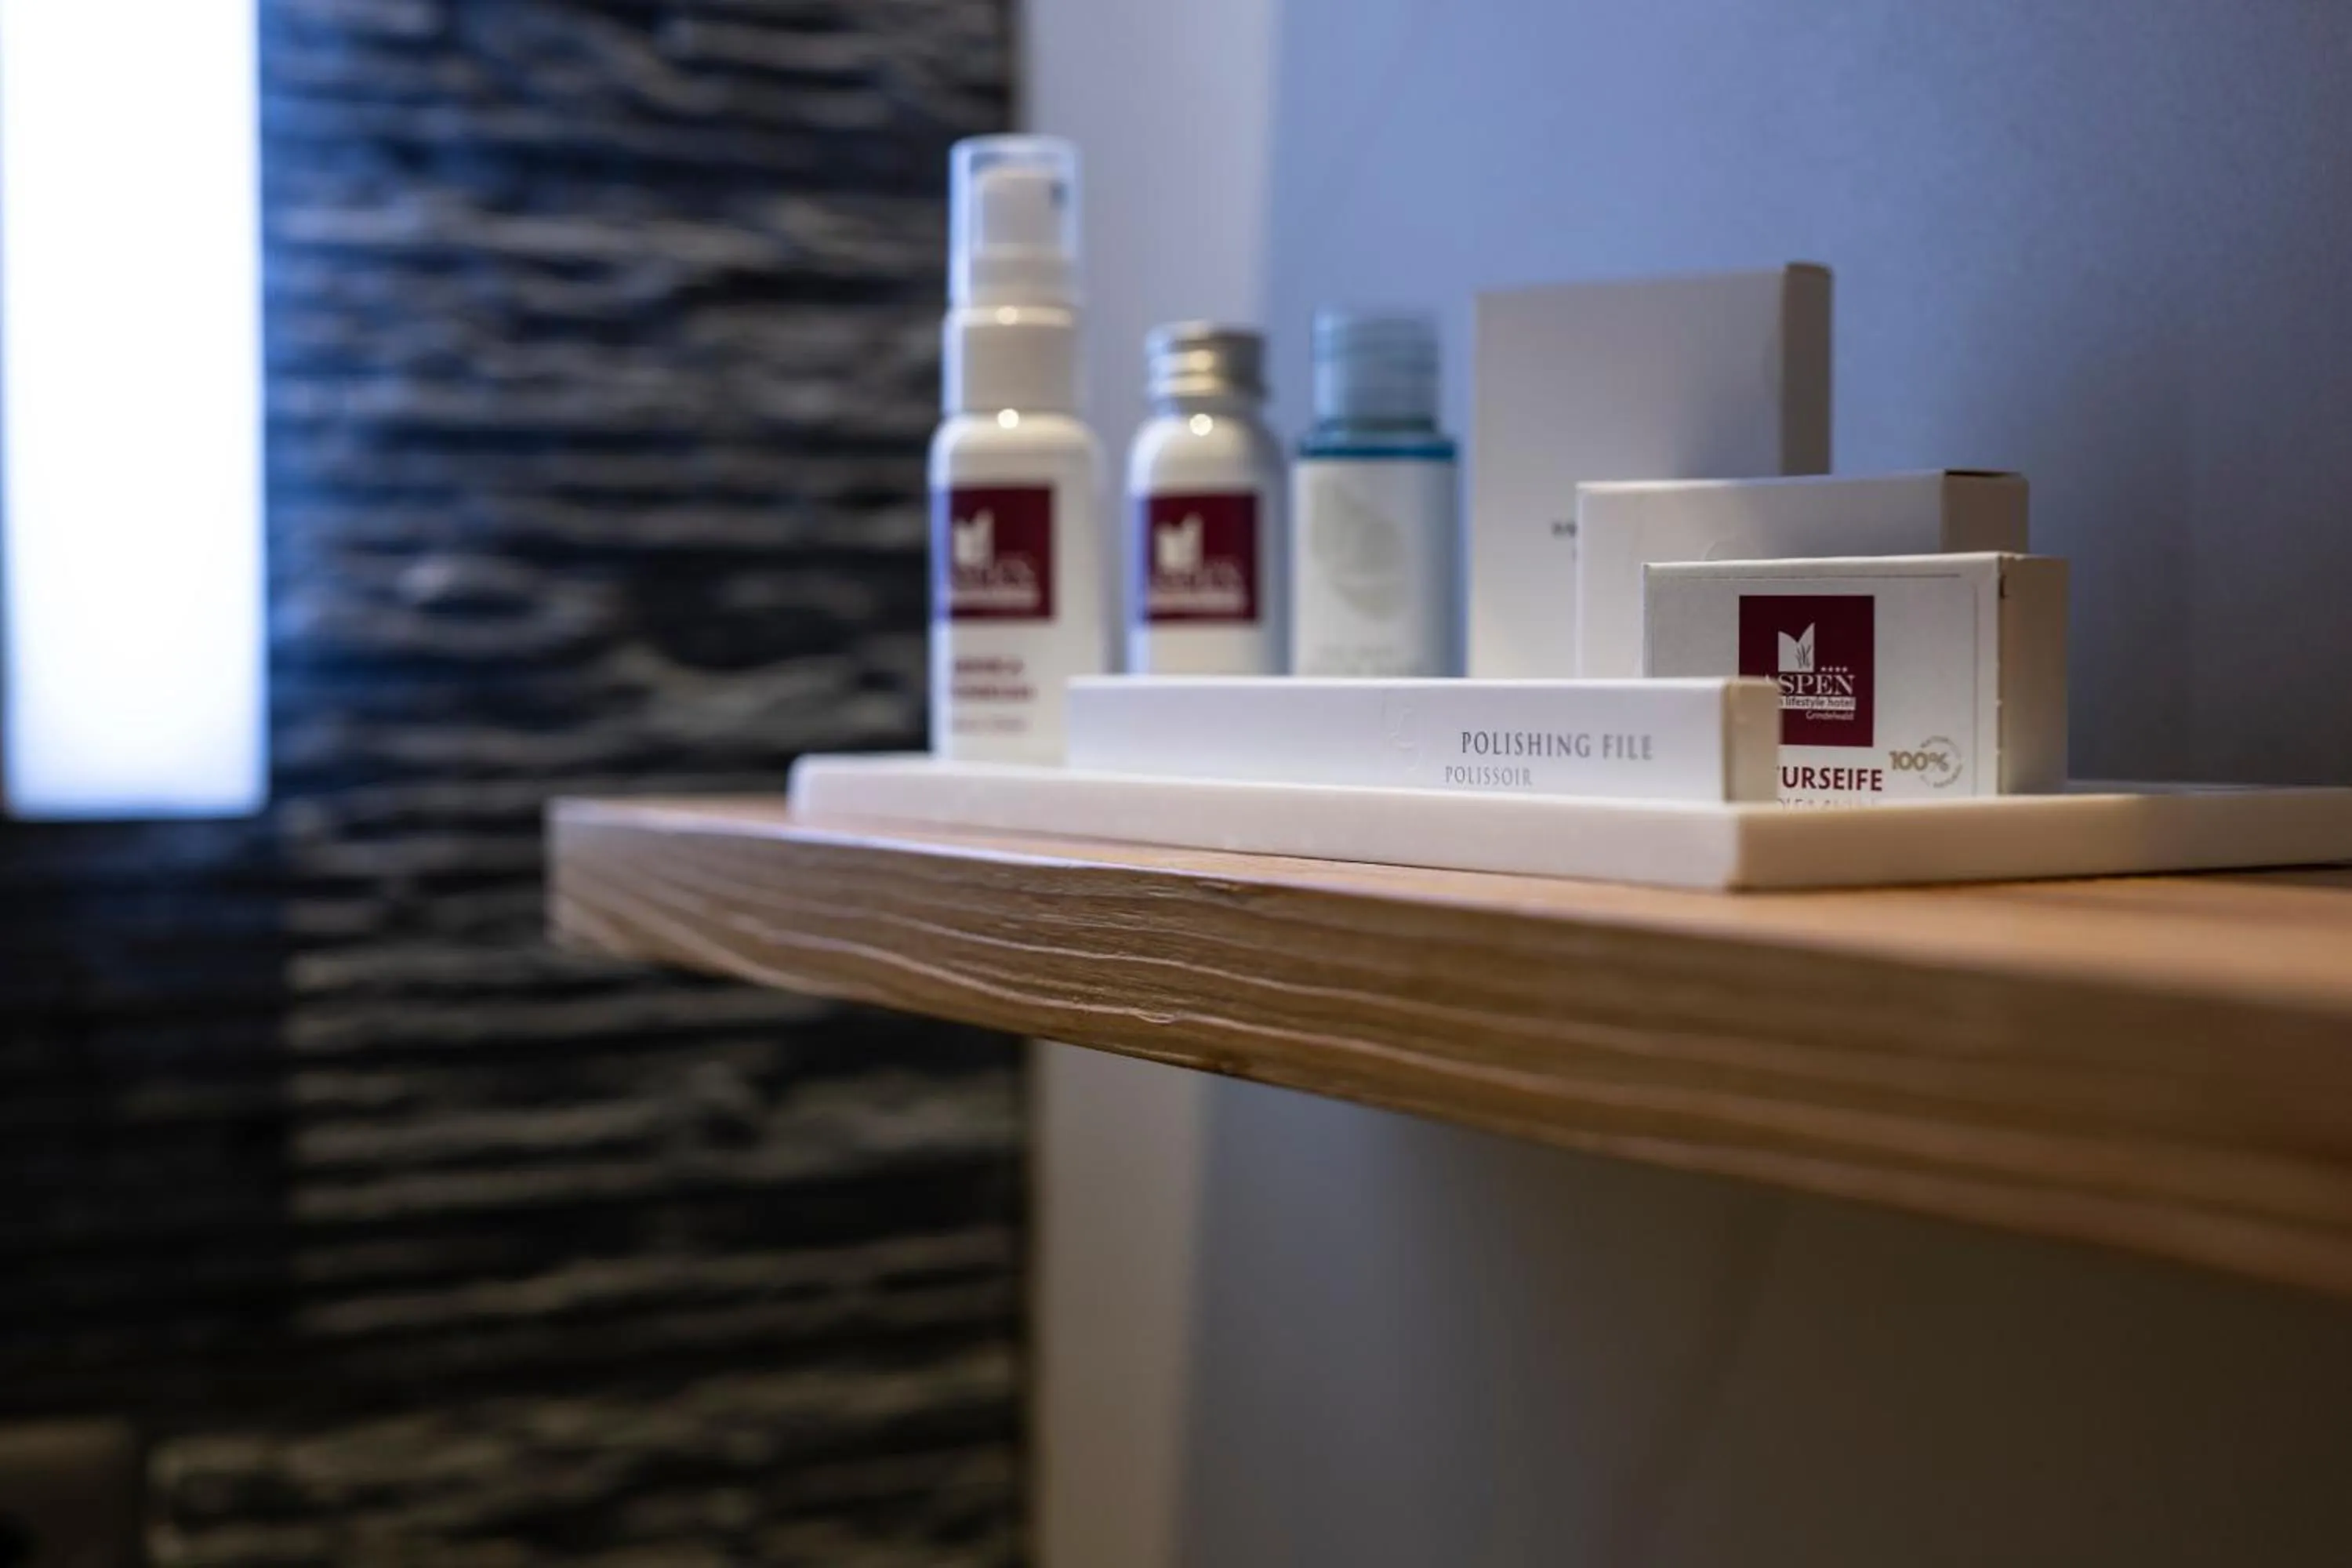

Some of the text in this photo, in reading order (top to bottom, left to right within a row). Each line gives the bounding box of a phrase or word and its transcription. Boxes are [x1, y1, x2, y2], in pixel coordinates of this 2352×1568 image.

[1769, 673, 1855, 695] SPEN
[1461, 731, 1653, 760] POLISHING FILE
[1889, 750, 1950, 772] 100%
[1445, 765, 1533, 786] POLISSOIR
[1780, 766, 1883, 792] URSEIFE
